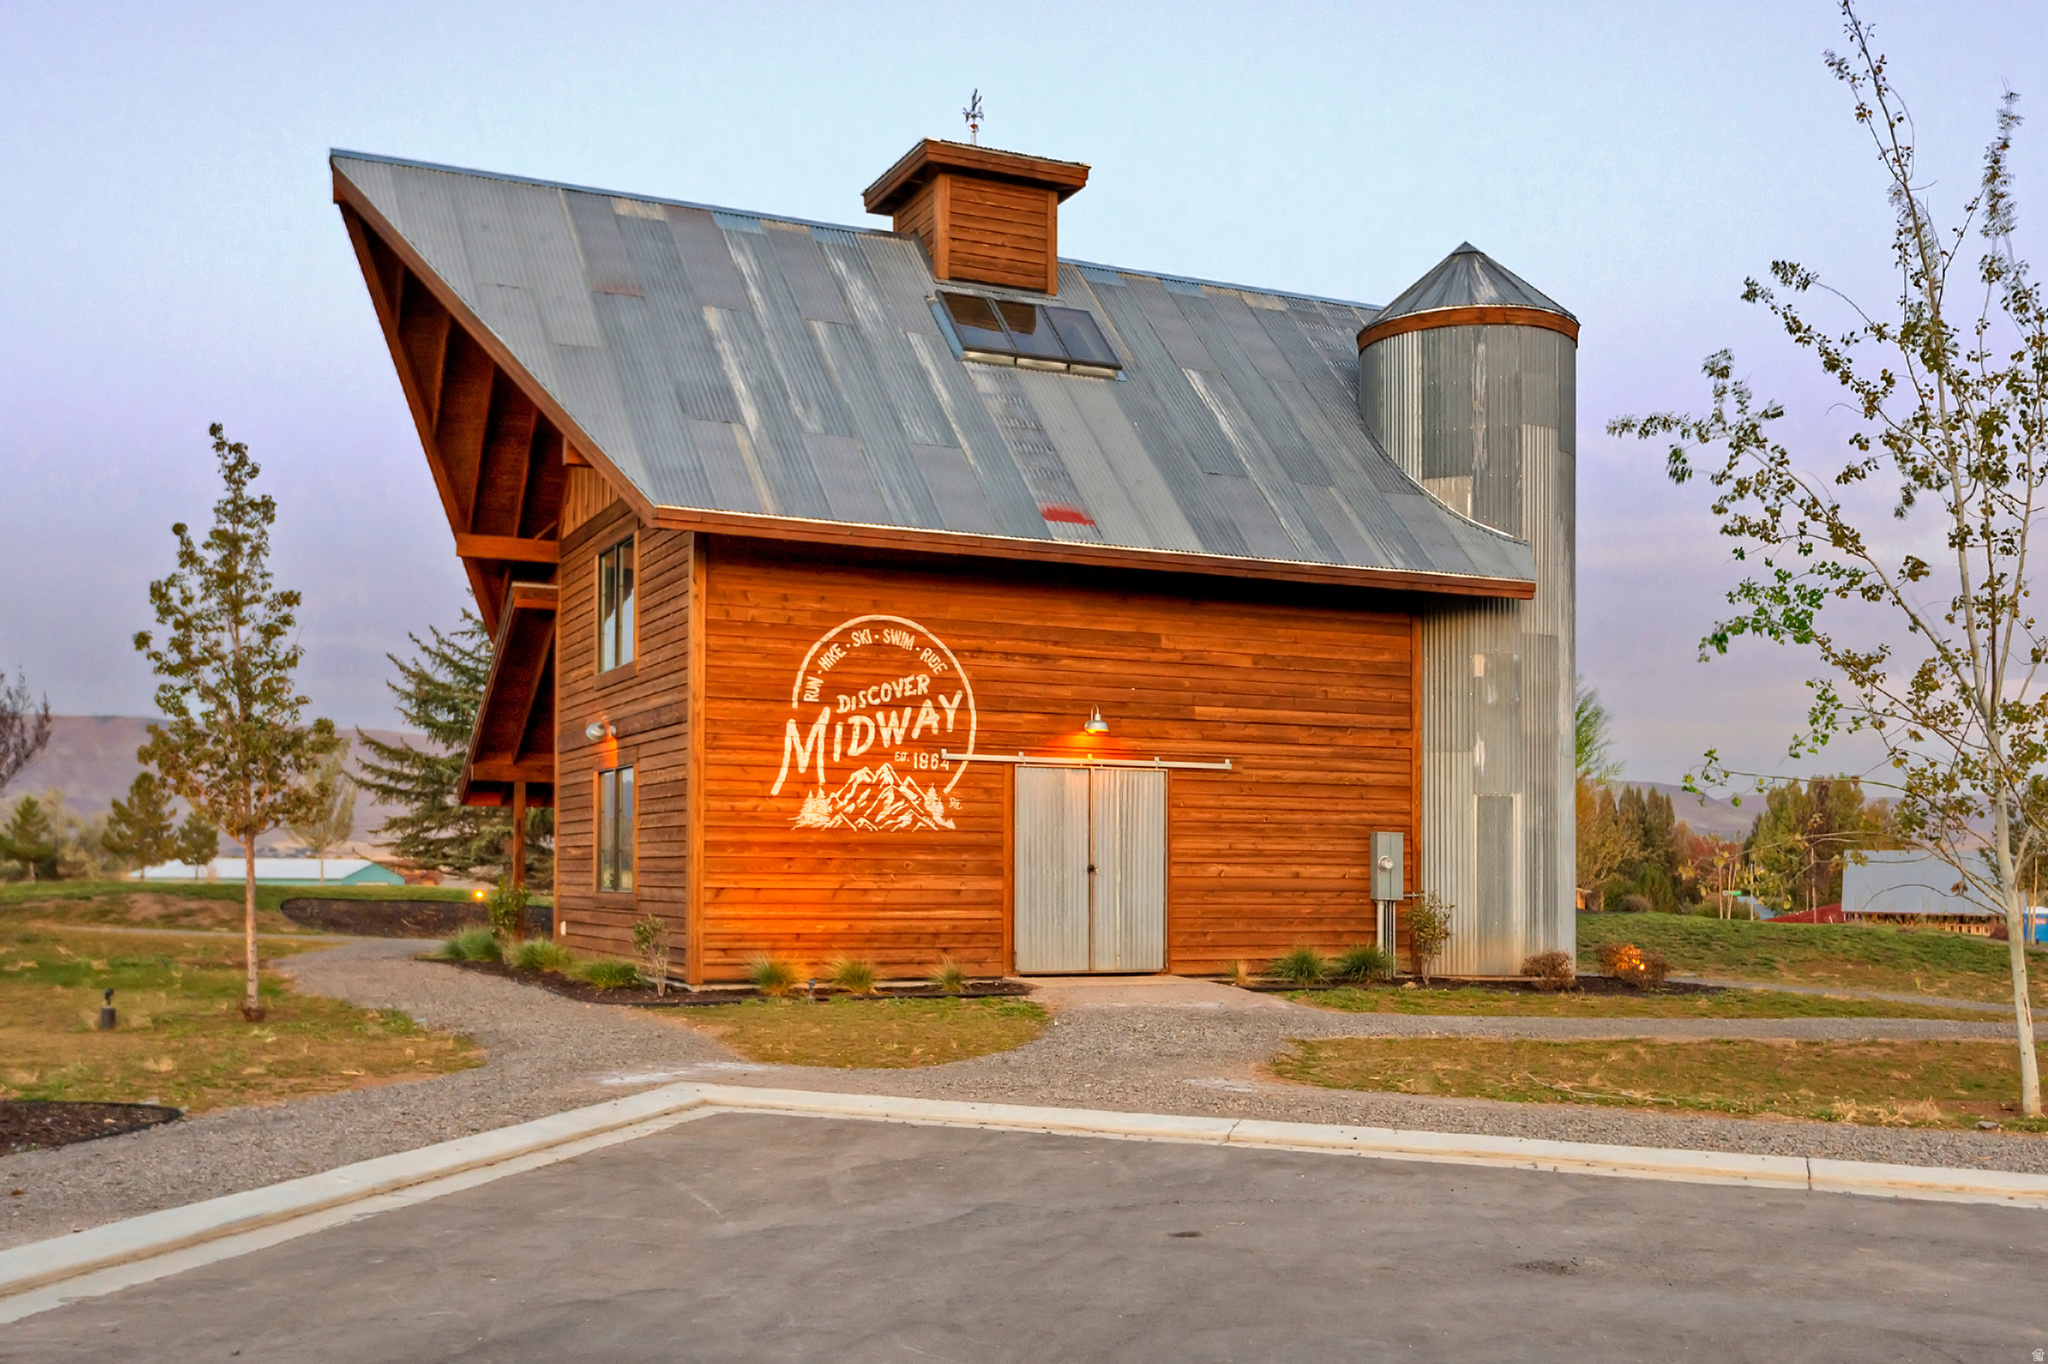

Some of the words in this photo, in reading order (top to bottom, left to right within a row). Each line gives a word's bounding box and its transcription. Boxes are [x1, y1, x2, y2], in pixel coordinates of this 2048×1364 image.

[803, 676, 824, 702] RUN
[817, 643, 847, 671] HIKE
[851, 628, 873, 647] SKI
[883, 628, 915, 651] SWIM
[920, 647, 948, 675] RIDE
[836, 674, 930, 714] DISCOVER
